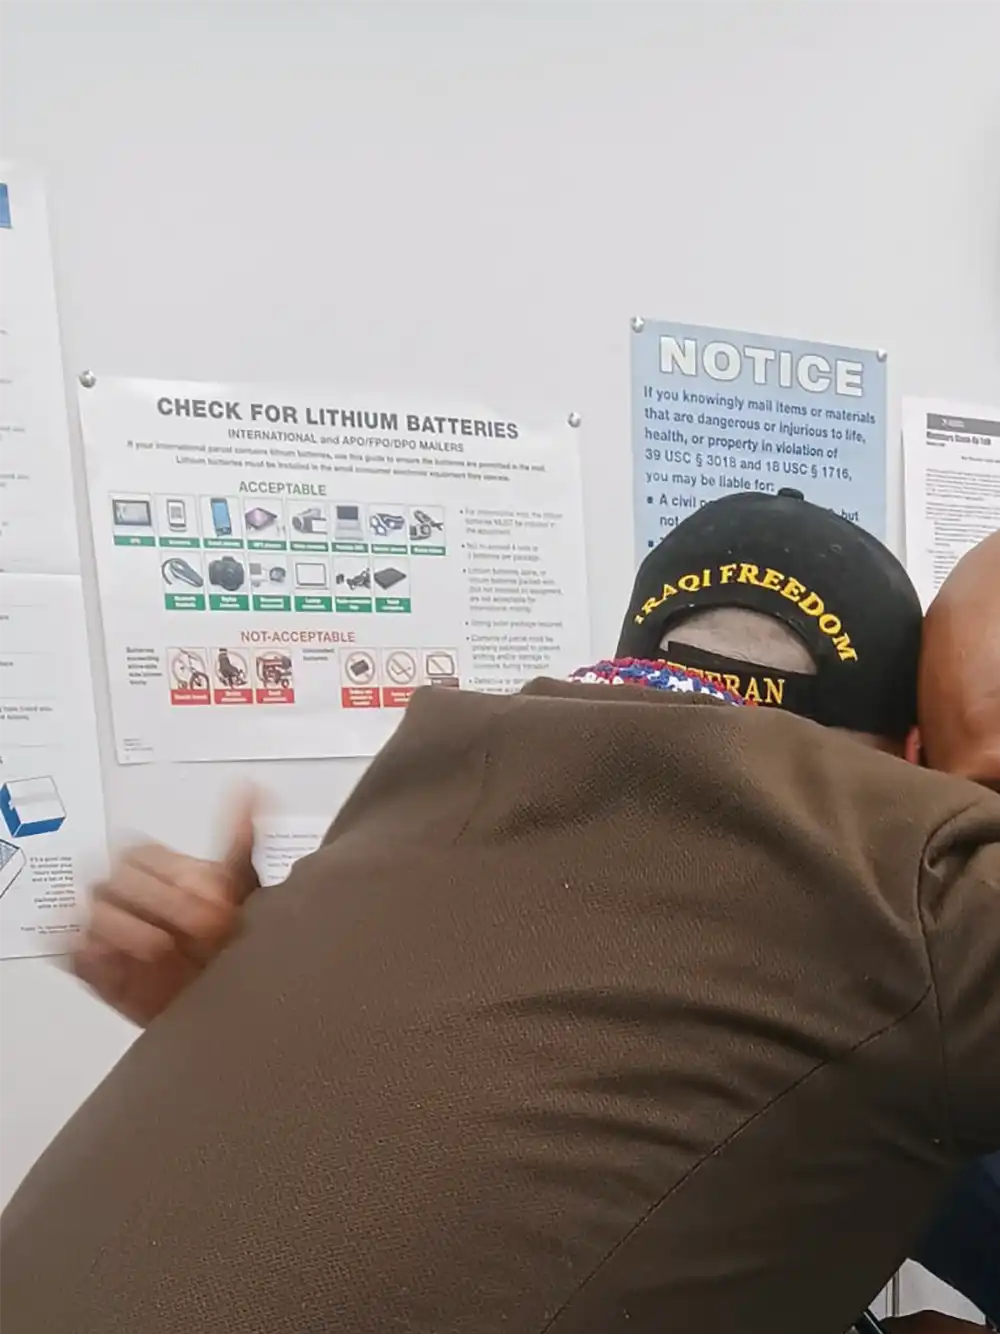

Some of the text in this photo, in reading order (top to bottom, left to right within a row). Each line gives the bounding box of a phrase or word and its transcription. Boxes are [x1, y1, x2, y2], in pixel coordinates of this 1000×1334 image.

[658, 334, 865, 397] NOTICE
[157, 396, 519, 440] CHECK FOR LITHIUM BATTERIES
[643, 385, 877, 425] If you knowingly mail items or materials
[227, 427, 464, 453] INTERNATIONAL and APO/FPO/DPO MAILERS
[644, 407, 867, 444] that are dangerous or injurious to life,
[644, 427, 839, 459] health, or property in violation of
[644, 448, 853, 482] 39 USC § 3018 and 18 USC § 1716,
[239, 480, 327, 496] ACCEPTABLE
[645, 471, 776, 492] you may be liable for:
[659, 493, 669, 506] A
[671, 494, 698, 508] civil
[659, 515, 680, 527] not
[633, 568, 712, 626] IRAQI
[719, 562, 859, 663] FREEDOM
[240, 630, 356, 643] NOT-ACCEPTABLE
